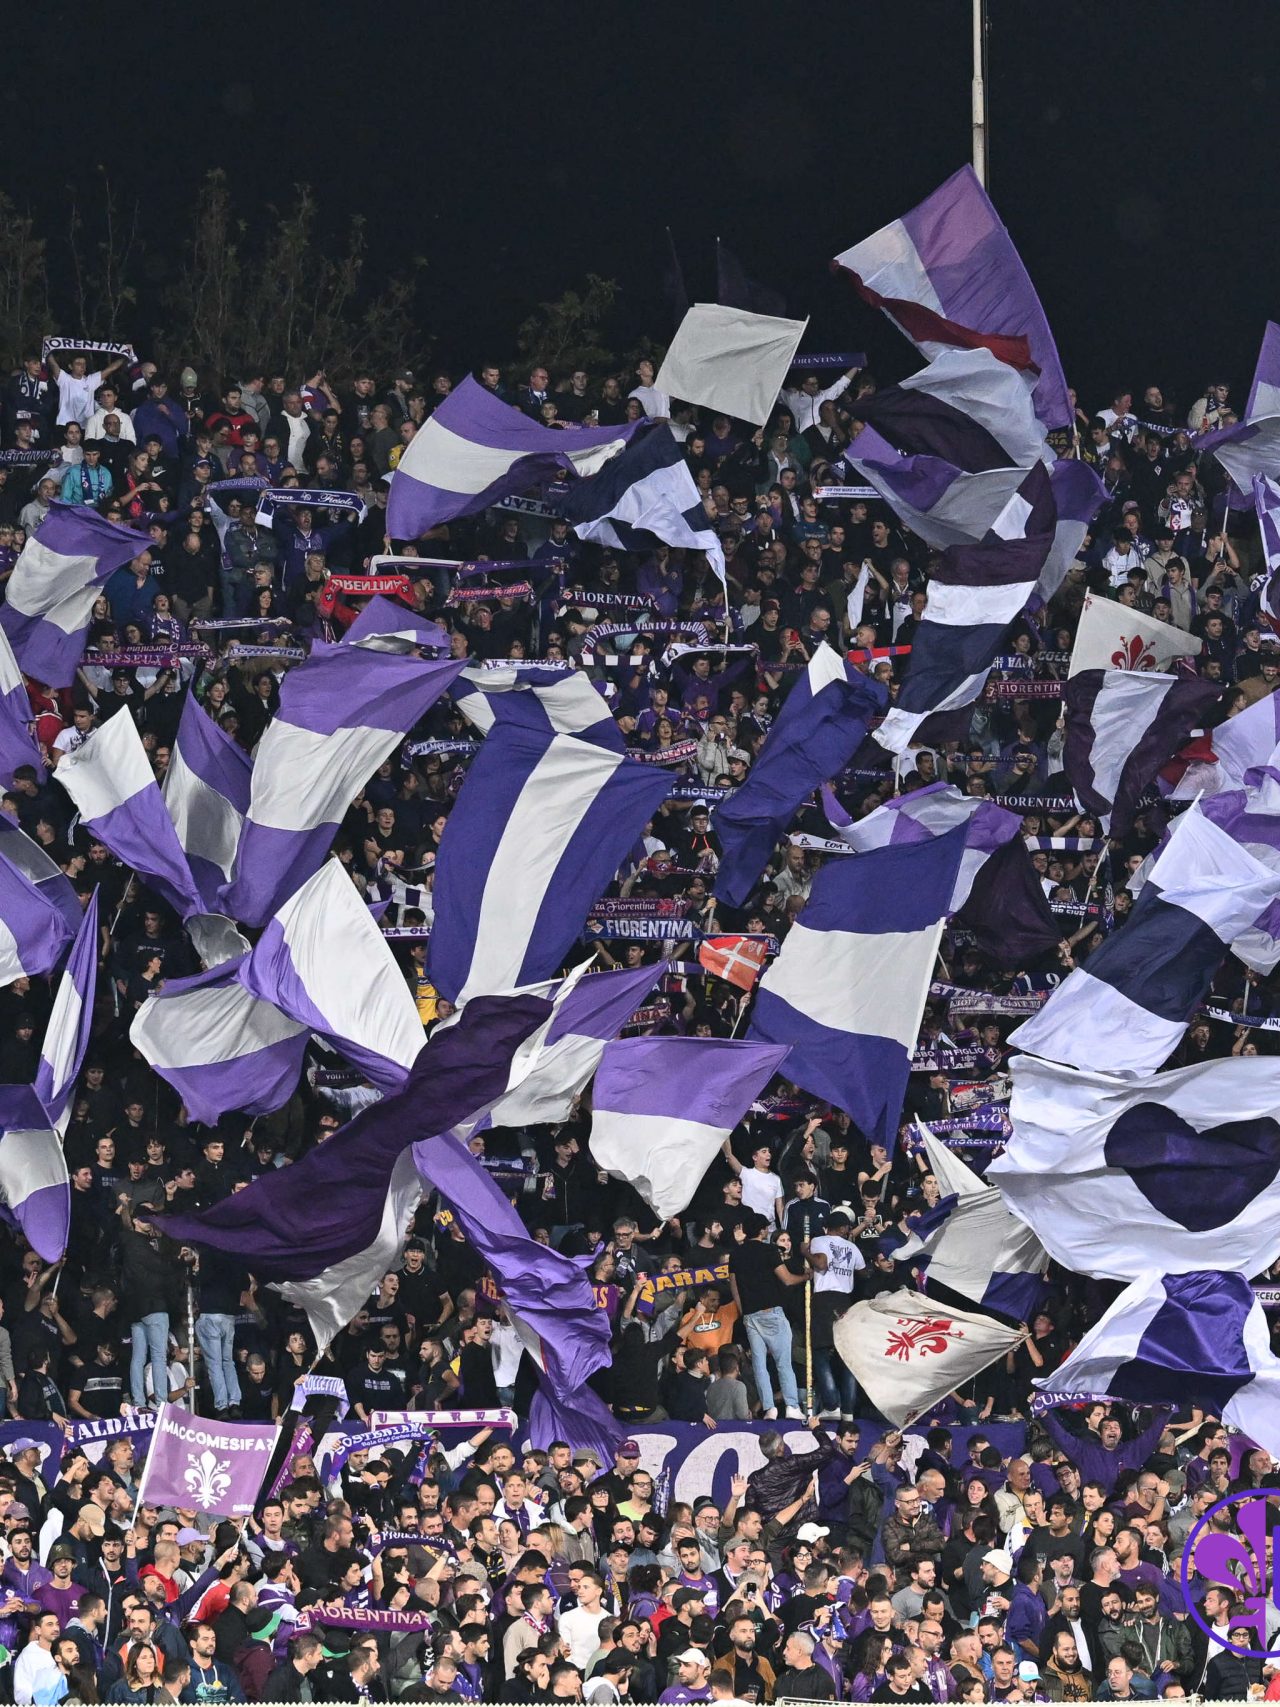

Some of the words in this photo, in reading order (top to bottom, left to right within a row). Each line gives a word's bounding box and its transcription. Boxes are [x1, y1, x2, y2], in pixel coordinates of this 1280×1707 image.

[46, 336, 138, 362] ORENTINA
[319, 492, 355, 505] Fiesole
[574, 591, 653, 608] FIORENTINA
[996, 796, 1074, 808] FIORENTINA
[606, 901, 656, 913] Fiorentina
[606, 918, 693, 939] FIORENTINA
[942, 1048, 952, 1057] IN
[953, 1047, 985, 1057] FIGLIO
[1034, 1392, 1086, 1410] CURVA
[64, 1415, 156, 1443] ALDAR
[162, 1418, 274, 1452] MACCOMESIFA?
